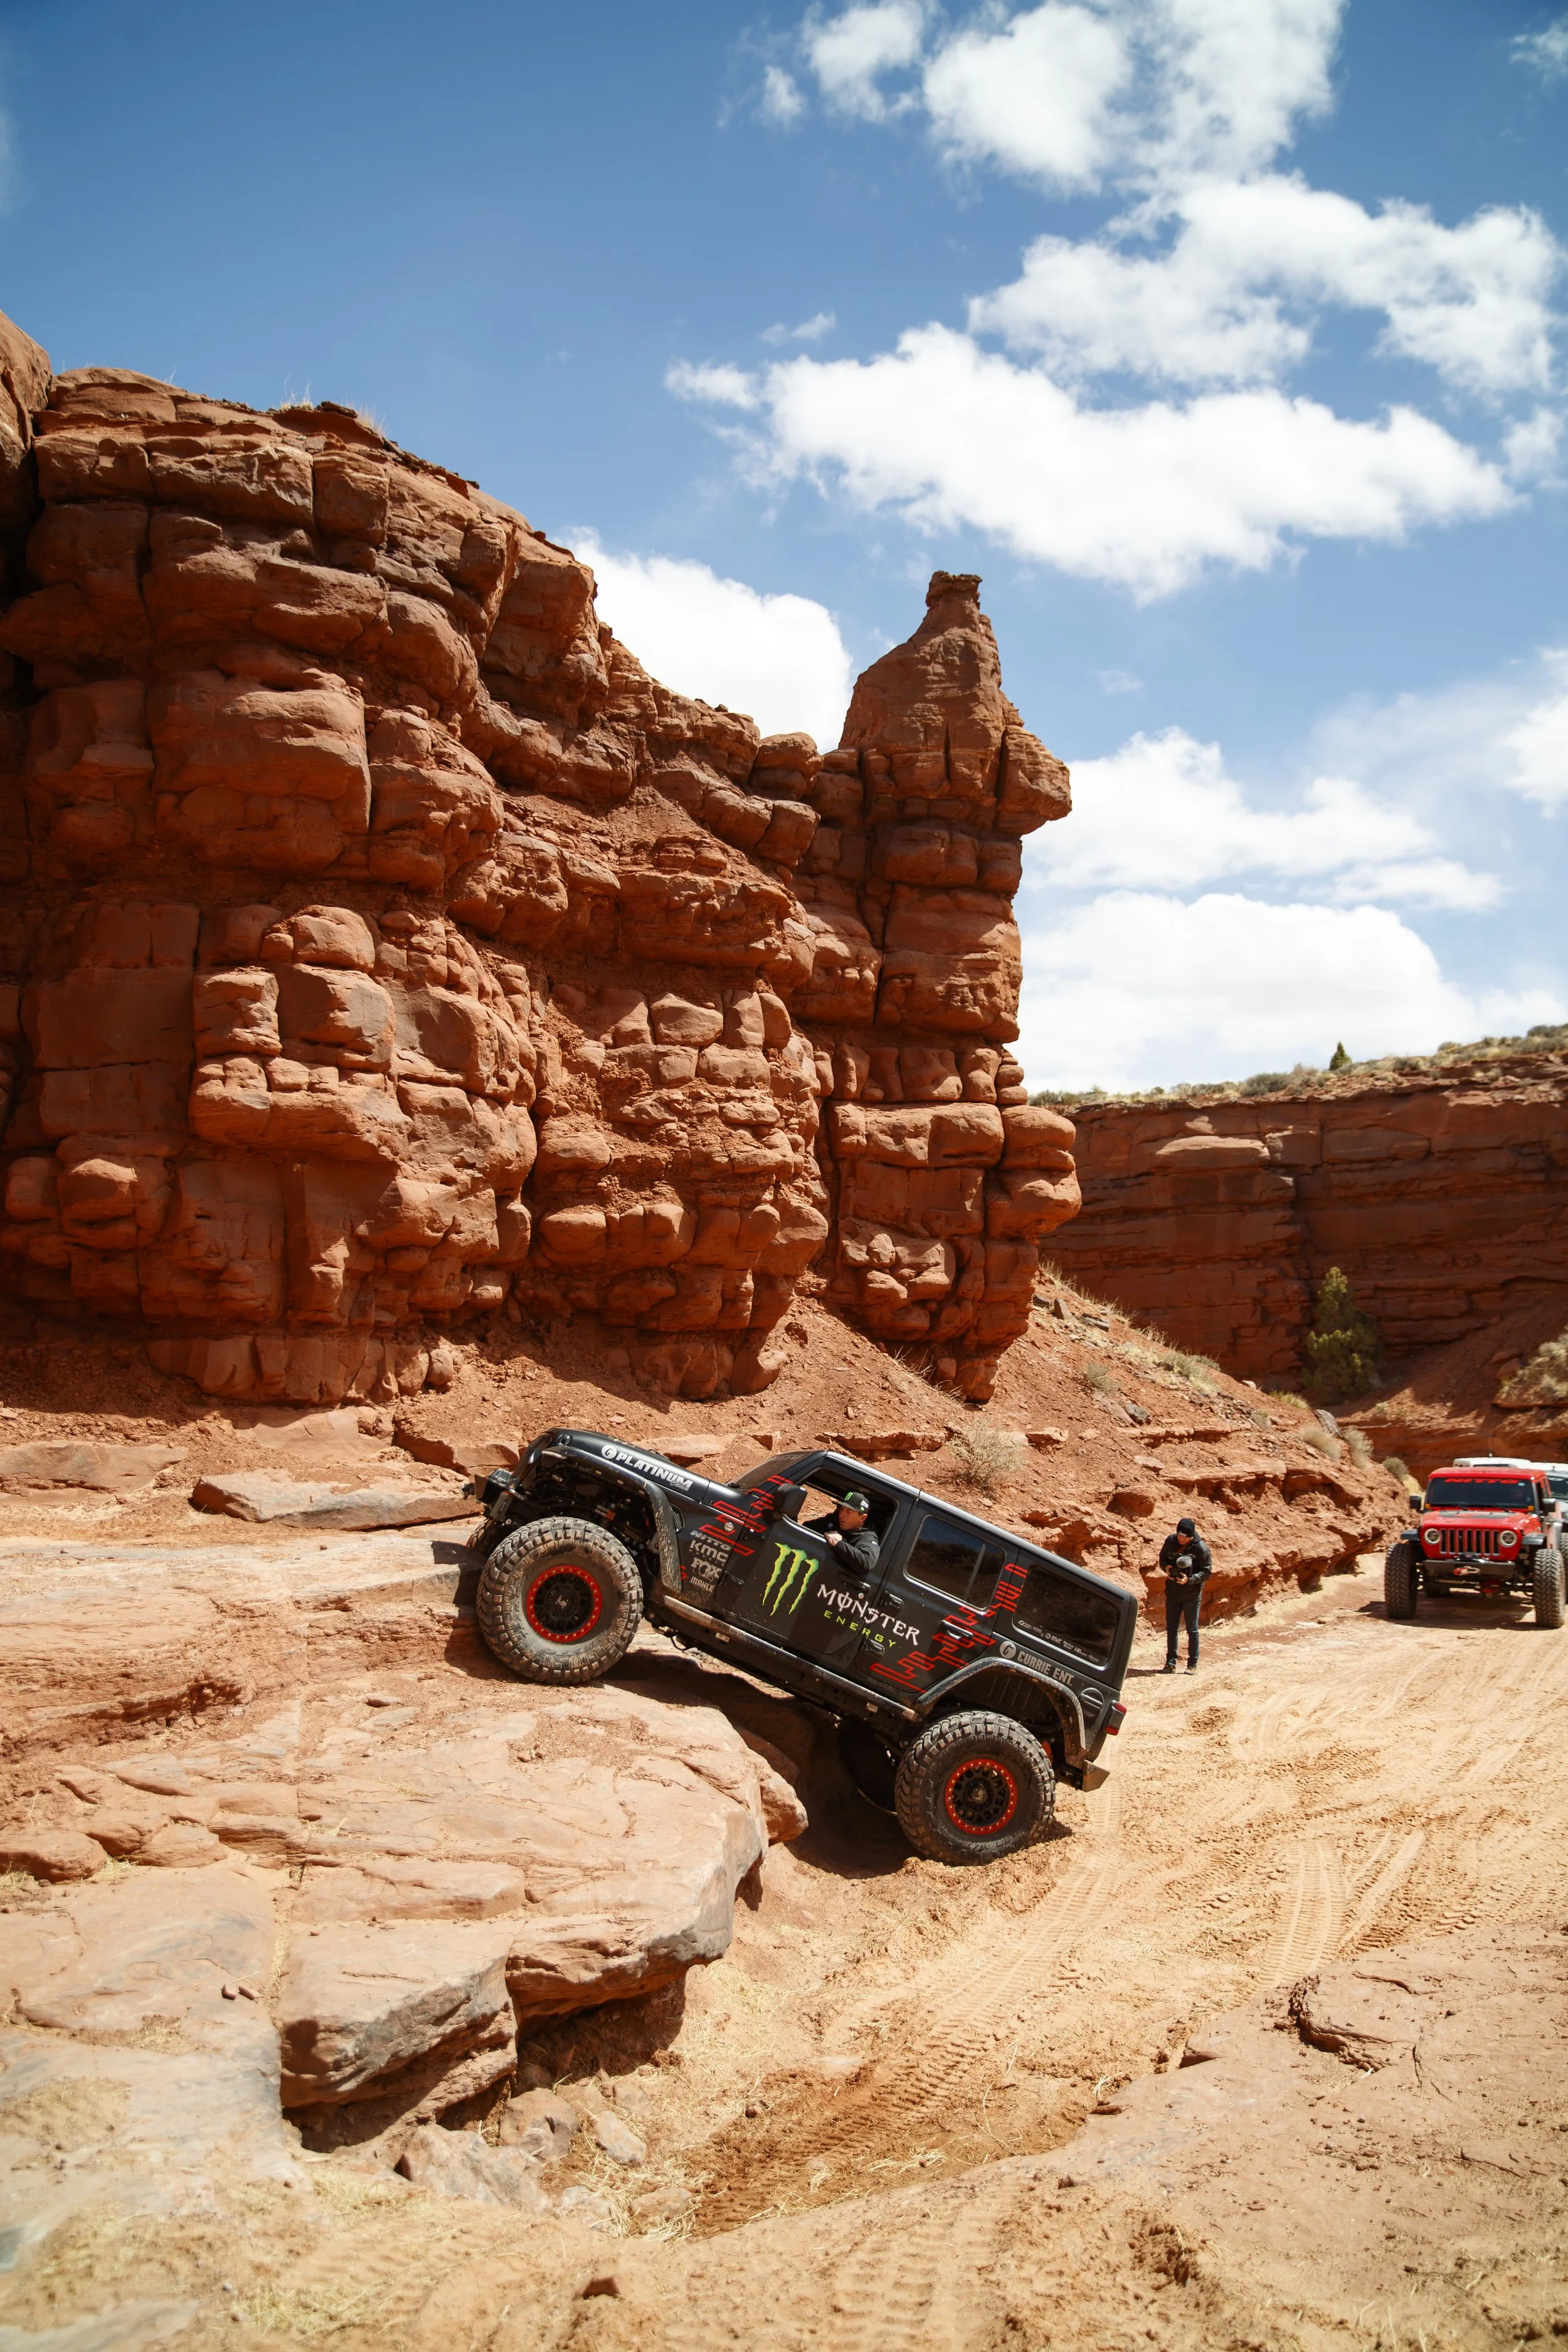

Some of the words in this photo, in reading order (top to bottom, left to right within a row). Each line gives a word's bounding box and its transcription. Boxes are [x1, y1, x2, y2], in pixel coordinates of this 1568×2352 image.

[616, 1452, 693, 1489] PLATINUM
[690, 1530, 731, 1550] NITTO
[690, 1576, 714, 1592] MAHLE
[691, 1557, 722, 1579] FOX
[817, 1584, 920, 1646] MONSTER
[824, 1610, 896, 1647] ENERGY
[1017, 1651, 1052, 1675] CURRIE
[1052, 1667, 1074, 1686] ENT.
